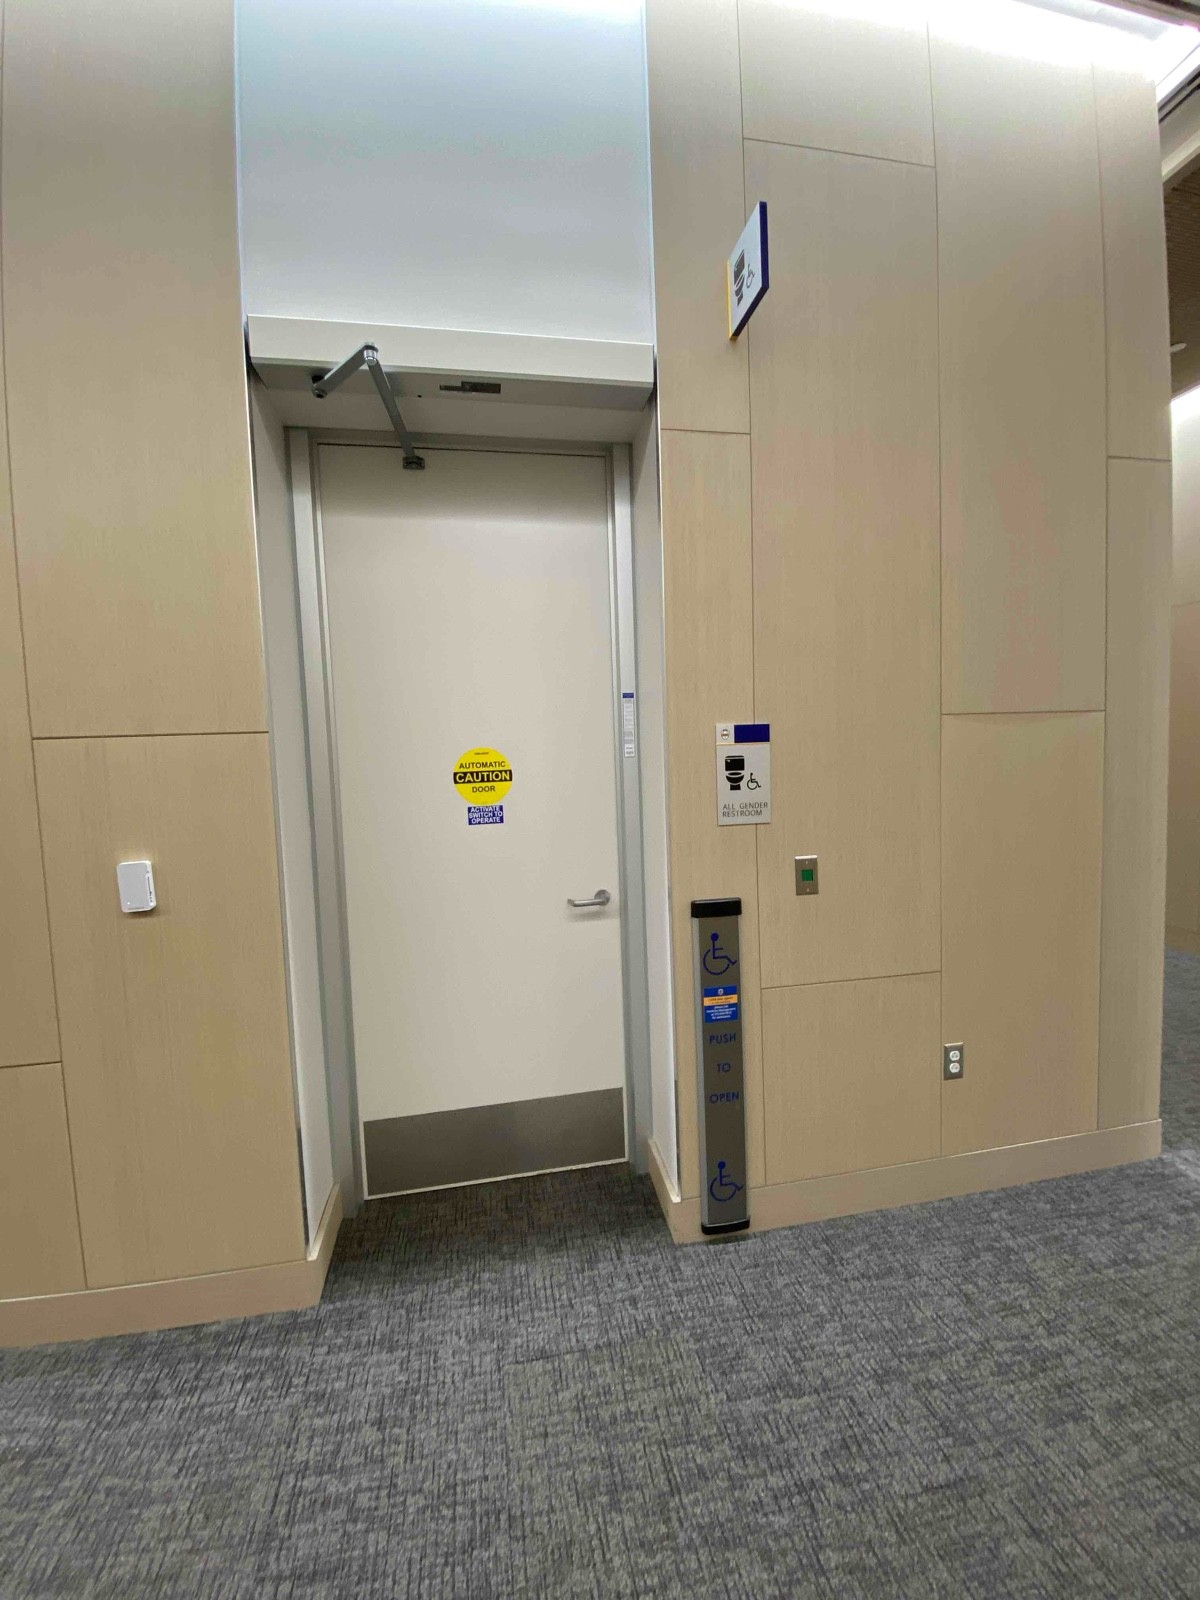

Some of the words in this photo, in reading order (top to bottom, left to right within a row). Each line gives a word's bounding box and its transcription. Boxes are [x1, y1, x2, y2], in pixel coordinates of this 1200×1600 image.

[459, 761, 506, 769] AUTOMATIC
[456, 771, 510, 782] CAUTION
[472, 785, 496, 793] DOOR
[739, 801, 768, 810] GENDER
[722, 809, 762, 818] RESTROOM
[709, 1033, 736, 1044] PUSH
[717, 1063, 731, 1073] TO
[709, 1092, 739, 1104] OPEN
